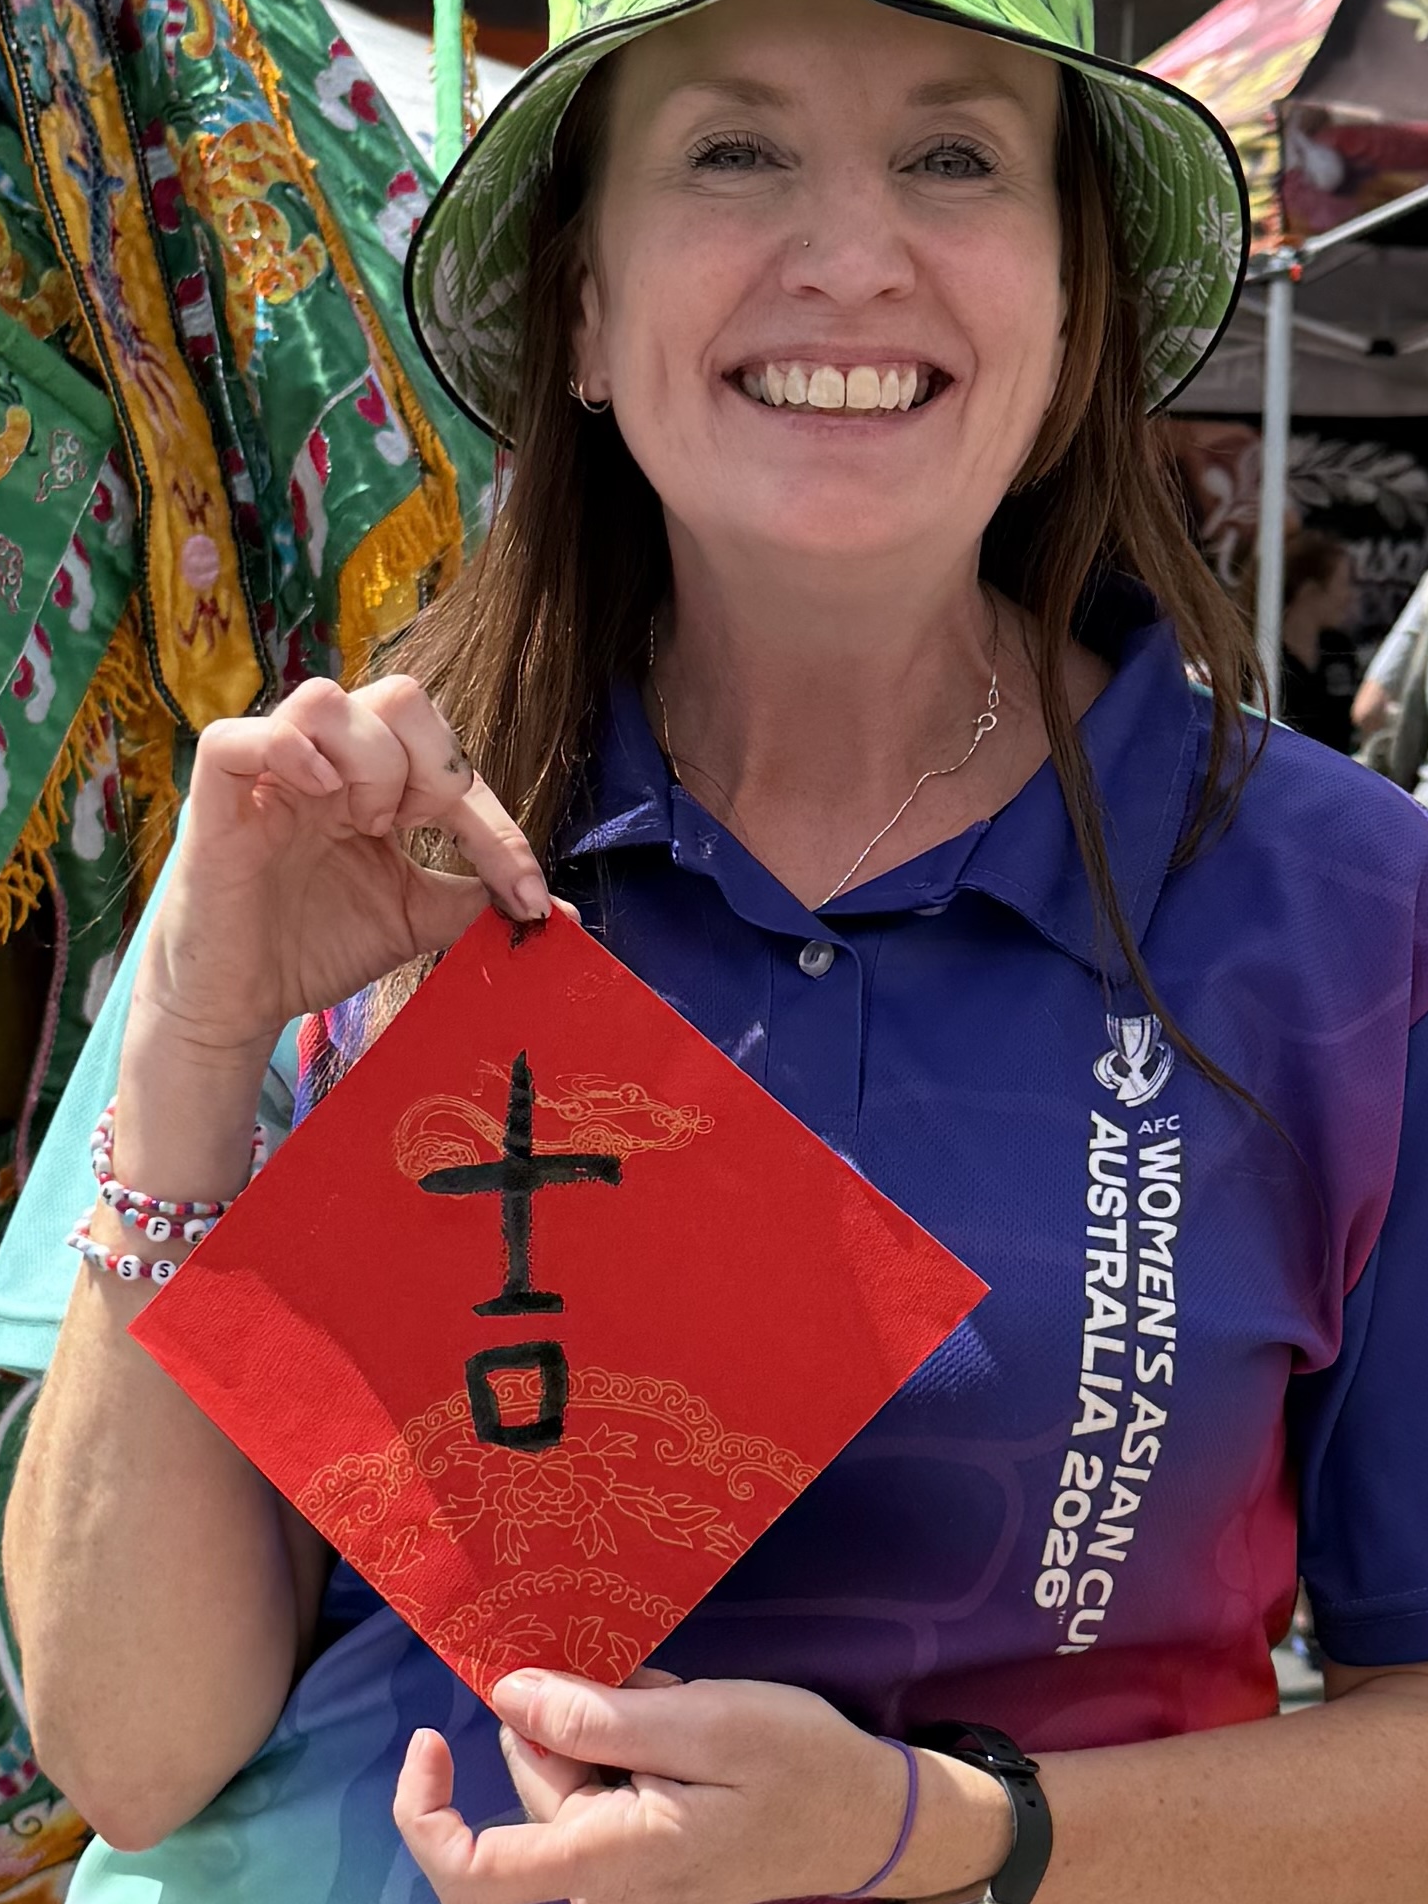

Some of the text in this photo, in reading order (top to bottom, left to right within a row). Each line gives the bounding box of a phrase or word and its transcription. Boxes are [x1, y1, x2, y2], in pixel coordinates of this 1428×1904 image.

[1137, 1114, 1181, 1135] AFC
[1071, 1109, 1129, 1436] AUSTRALIA
[1135, 1137, 1181, 1386] WOMEN'S
[1087, 1391, 1168, 1562] ASIAN
